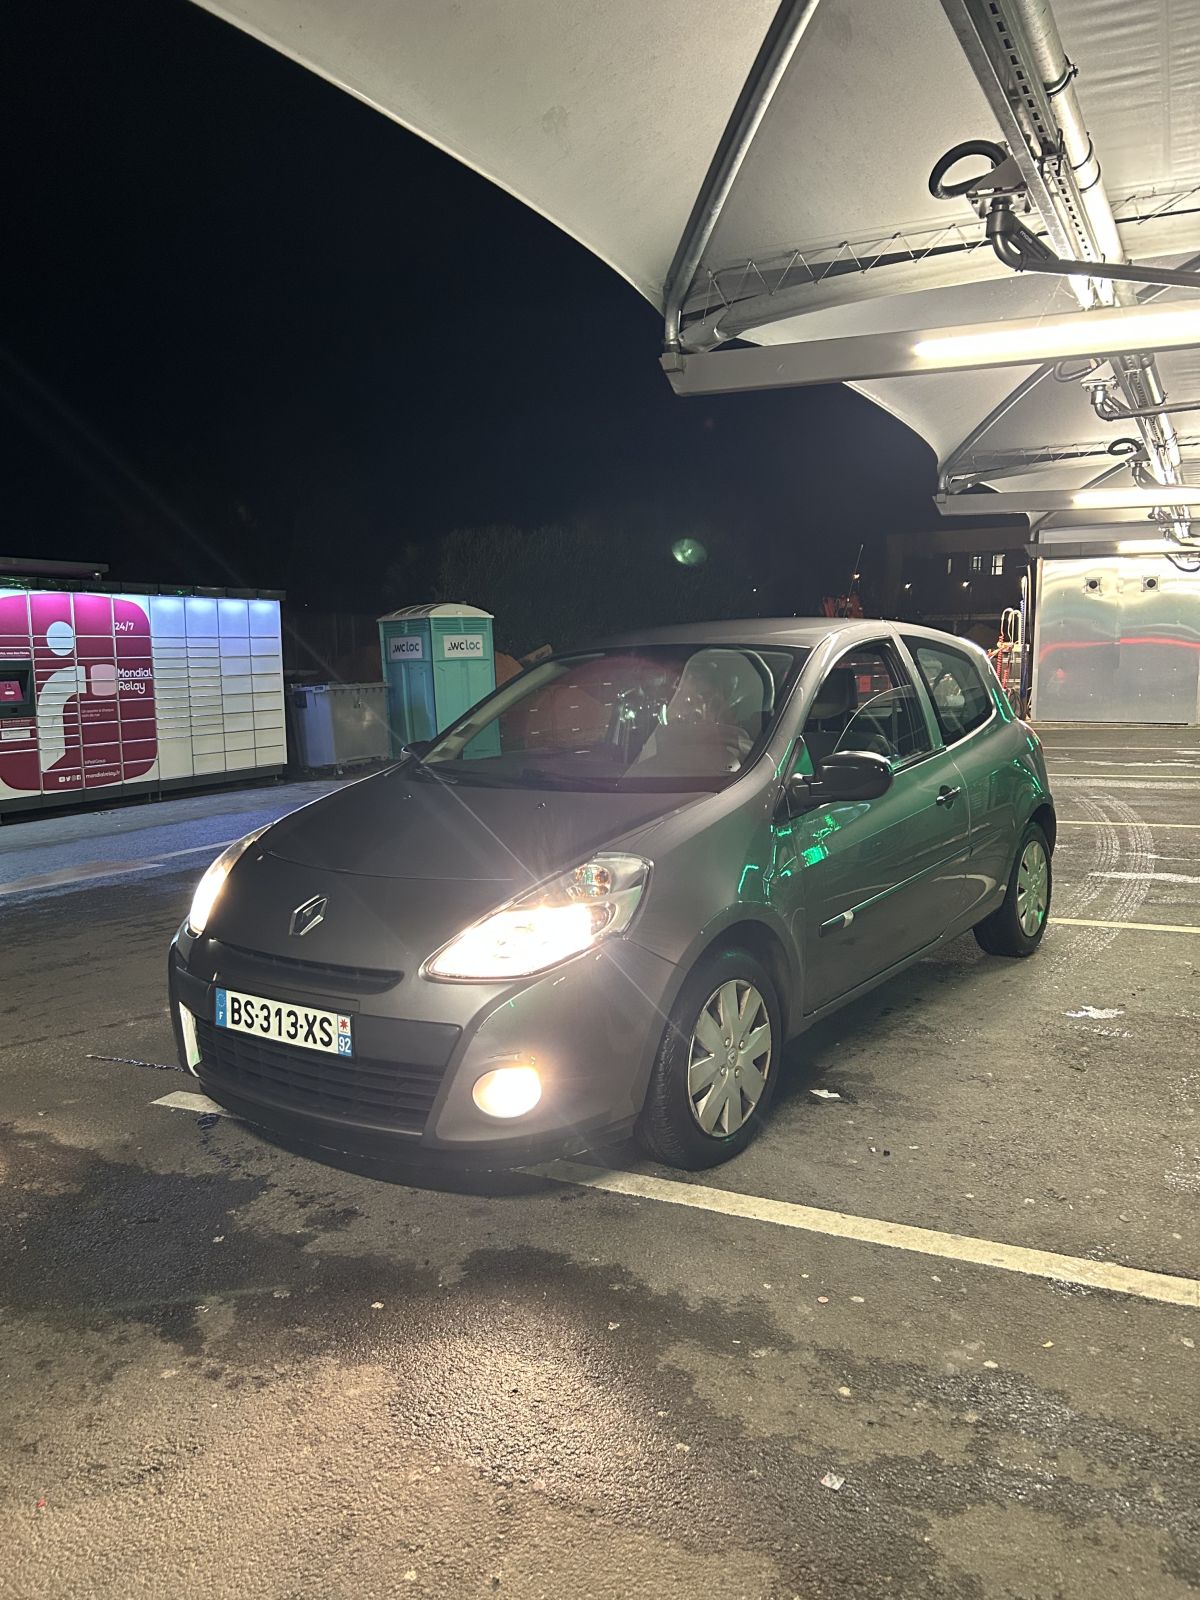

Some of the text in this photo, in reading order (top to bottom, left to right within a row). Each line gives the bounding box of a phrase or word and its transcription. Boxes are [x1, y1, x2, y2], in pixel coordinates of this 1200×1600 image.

[114, 622, 134, 631] 24/7
[117, 668, 152, 678] Mondial
[118, 681, 146, 694] Relay
[218, 1011, 224, 1020] F
[231, 997, 333, 1047] BS-313-XS
[338, 1037, 351, 1052] 92
